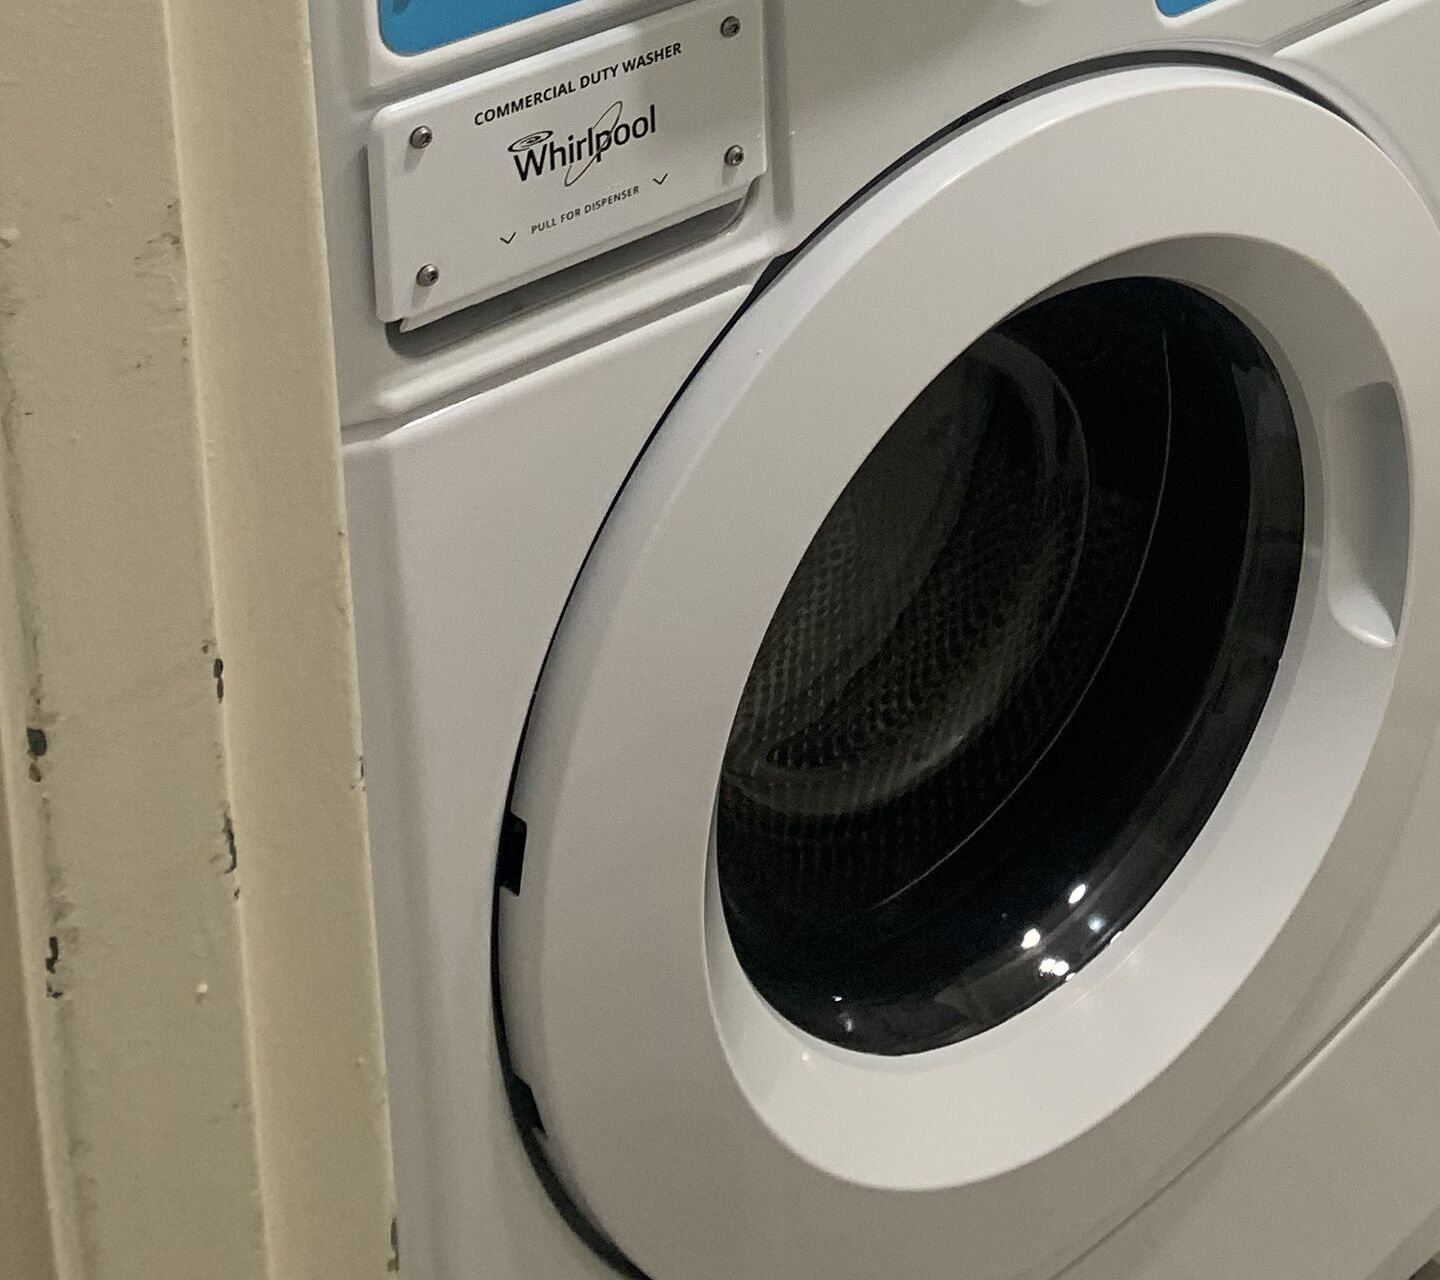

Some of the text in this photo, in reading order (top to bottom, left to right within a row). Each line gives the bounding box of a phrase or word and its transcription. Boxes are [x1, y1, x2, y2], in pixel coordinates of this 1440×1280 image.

[474, 41, 682, 126] COMMERCIAL DUTY WASHER
[513, 104, 657, 183] Whirlpool
[530, 185, 640, 235] PULL FOR DISPENSER
